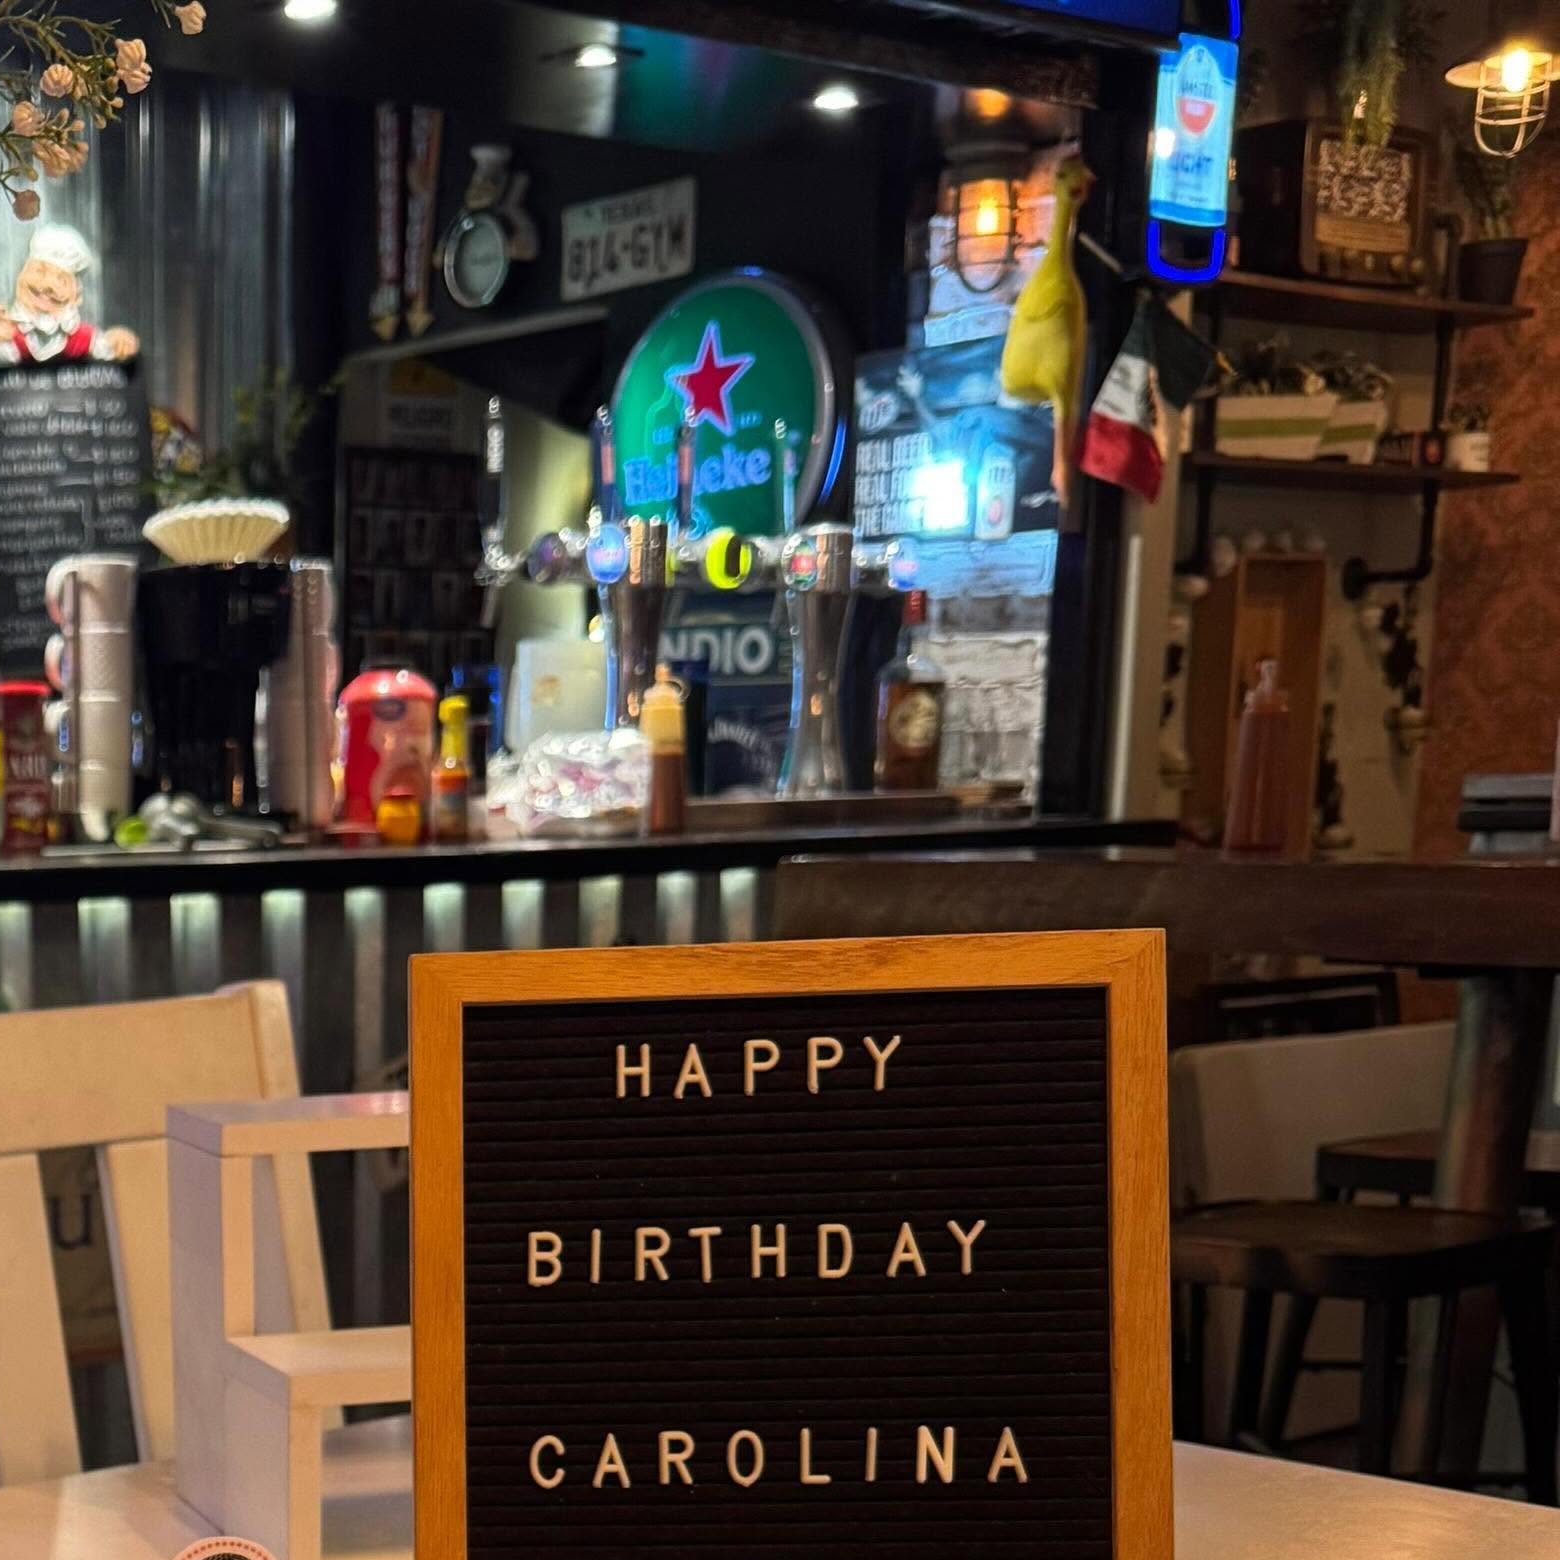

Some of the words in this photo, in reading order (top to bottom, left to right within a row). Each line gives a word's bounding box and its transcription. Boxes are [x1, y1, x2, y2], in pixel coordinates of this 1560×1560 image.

[624, 444, 772, 505] Heieke
[656, 626, 772, 675] NDIO
[616, 1034, 902, 1099] HAPPY
[527, 1219, 987, 1288] BIRTHDAY
[529, 1425, 1029, 1490] CAROLINA
